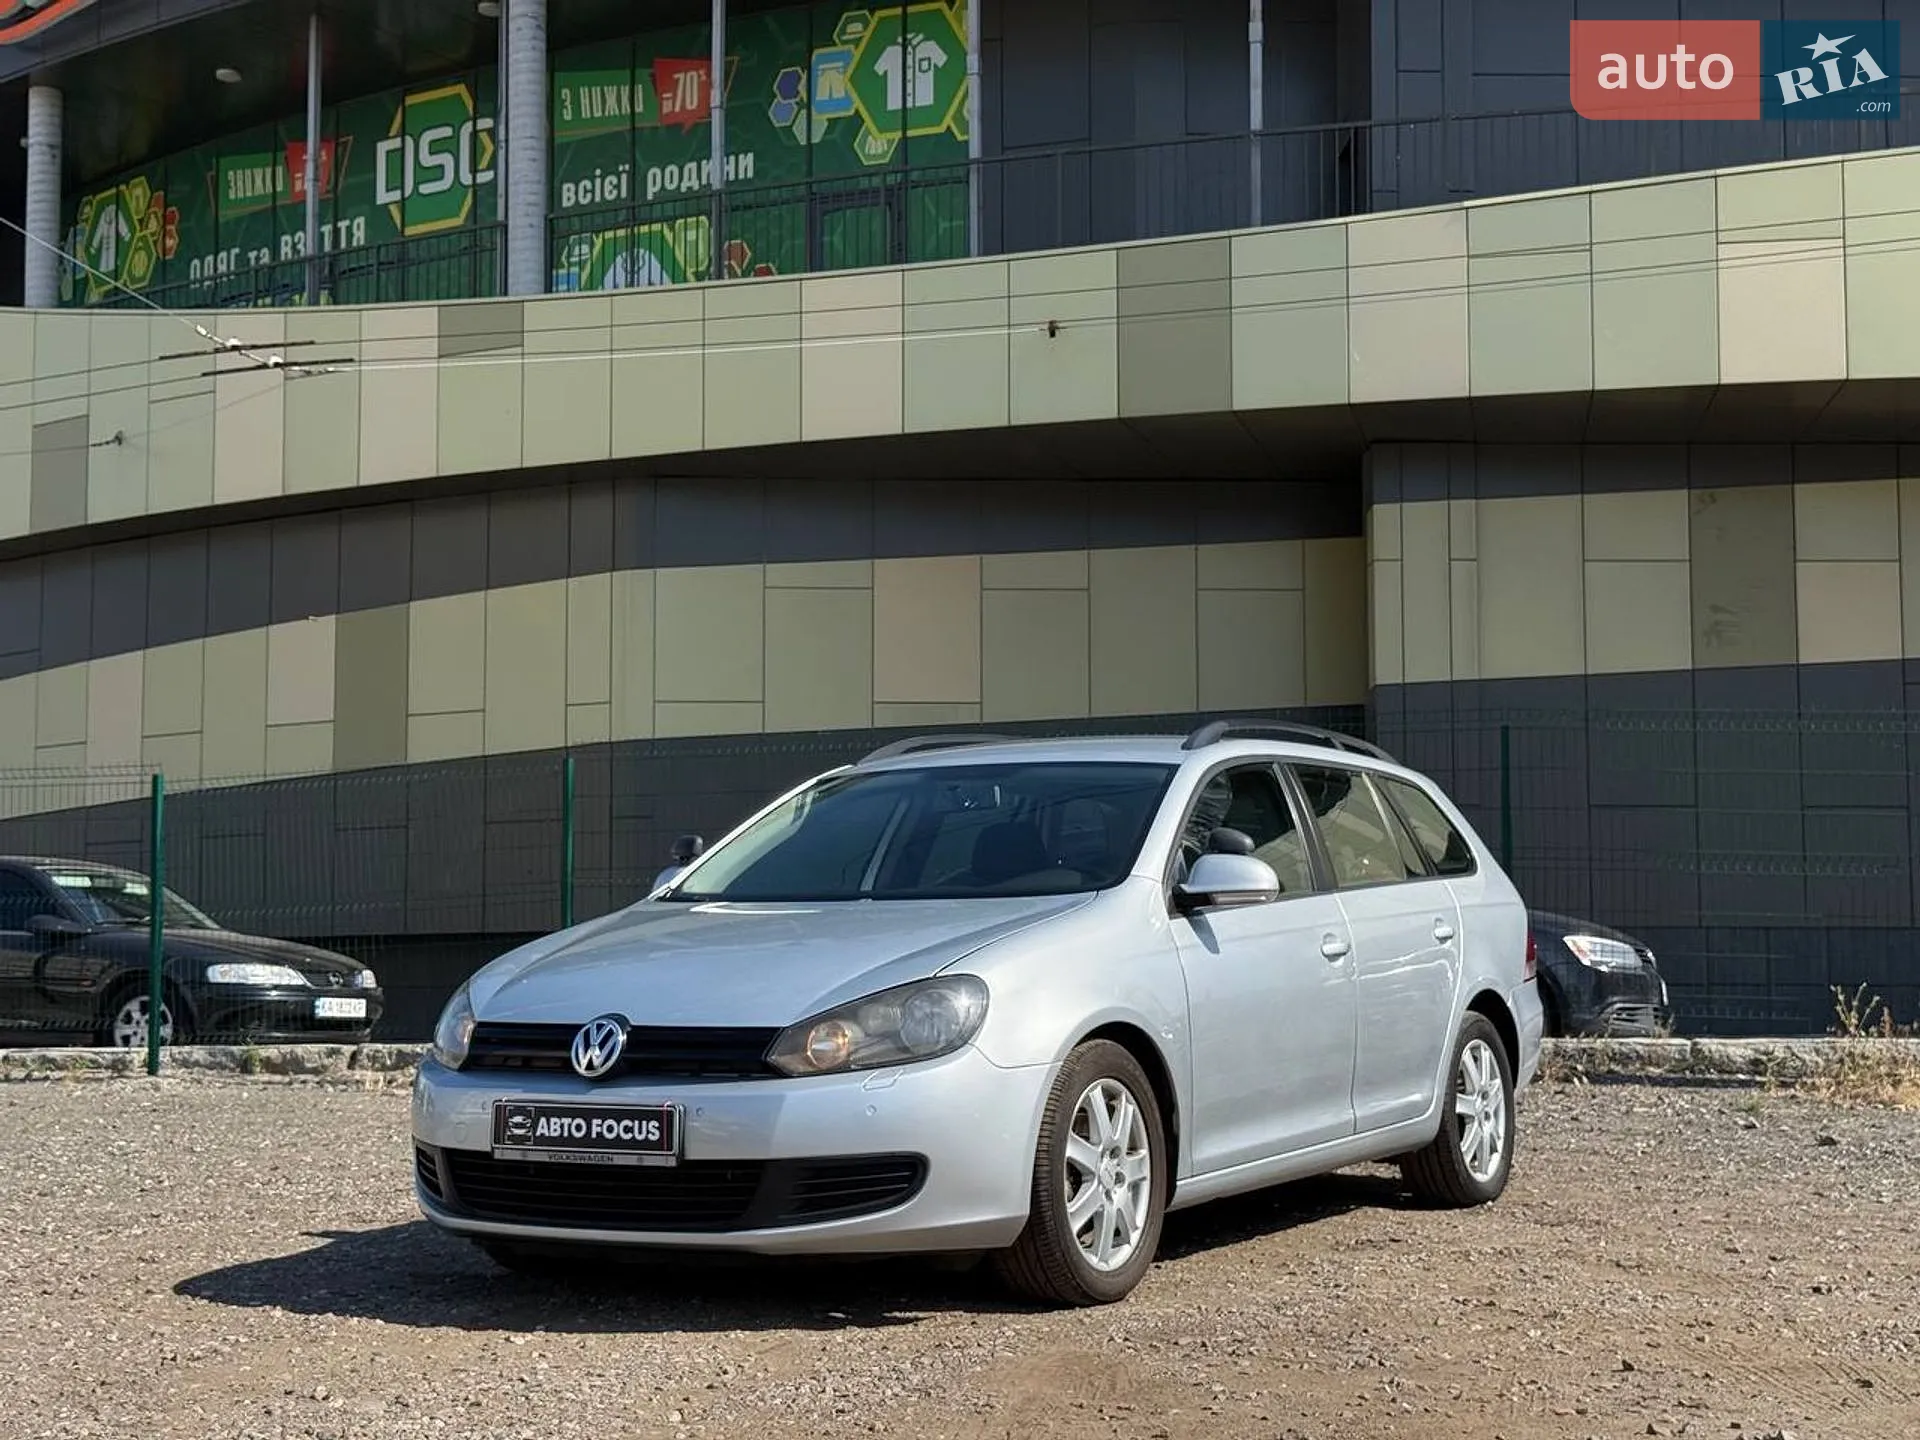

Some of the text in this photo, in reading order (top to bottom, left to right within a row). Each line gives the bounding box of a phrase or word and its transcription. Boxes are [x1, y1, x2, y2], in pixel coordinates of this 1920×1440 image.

[376, 118, 494, 205] DSC
[562, 164, 630, 208] всієї
[591, 1118, 660, 1142] FOCUS
